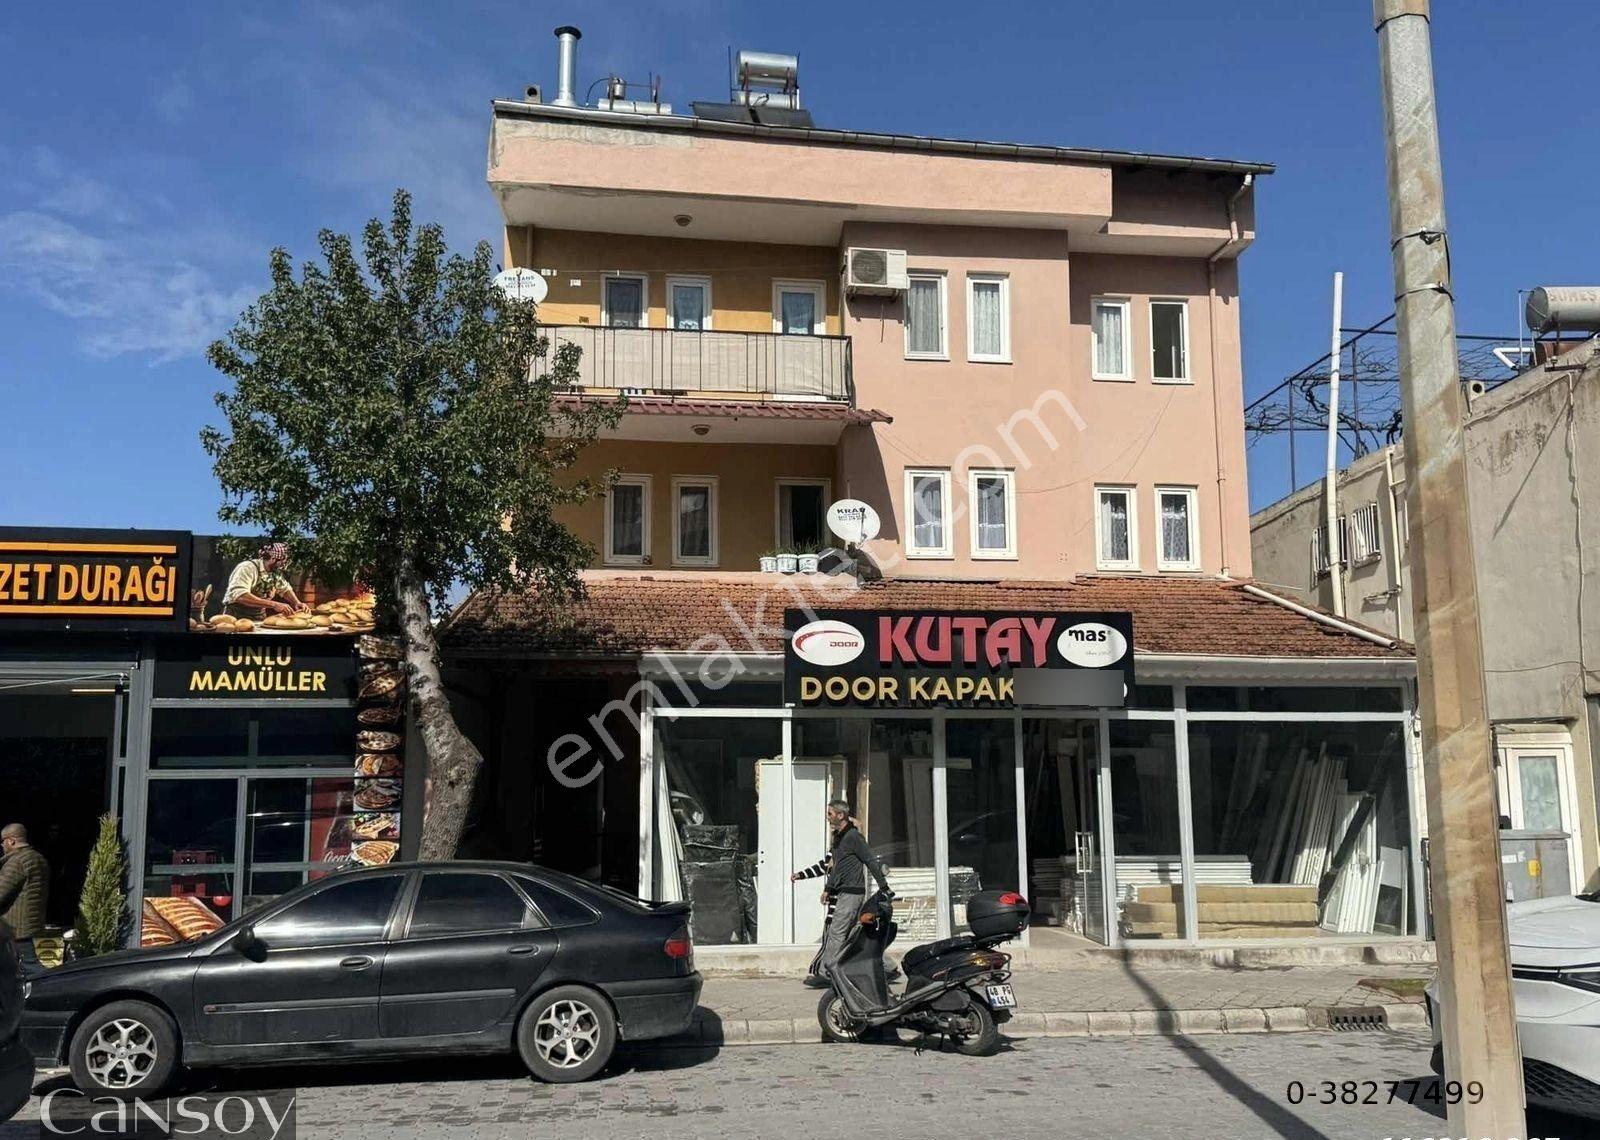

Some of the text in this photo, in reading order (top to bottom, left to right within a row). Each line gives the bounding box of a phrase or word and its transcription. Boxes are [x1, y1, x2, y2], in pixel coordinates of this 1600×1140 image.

[58, 556, 177, 602] DURAĞI
[878, 615, 1057, 669] KUTAY
[227, 645, 292, 666] UNLU
[189, 666, 327, 692] MAMÜLLER
[800, 676, 898, 701] DOOR
